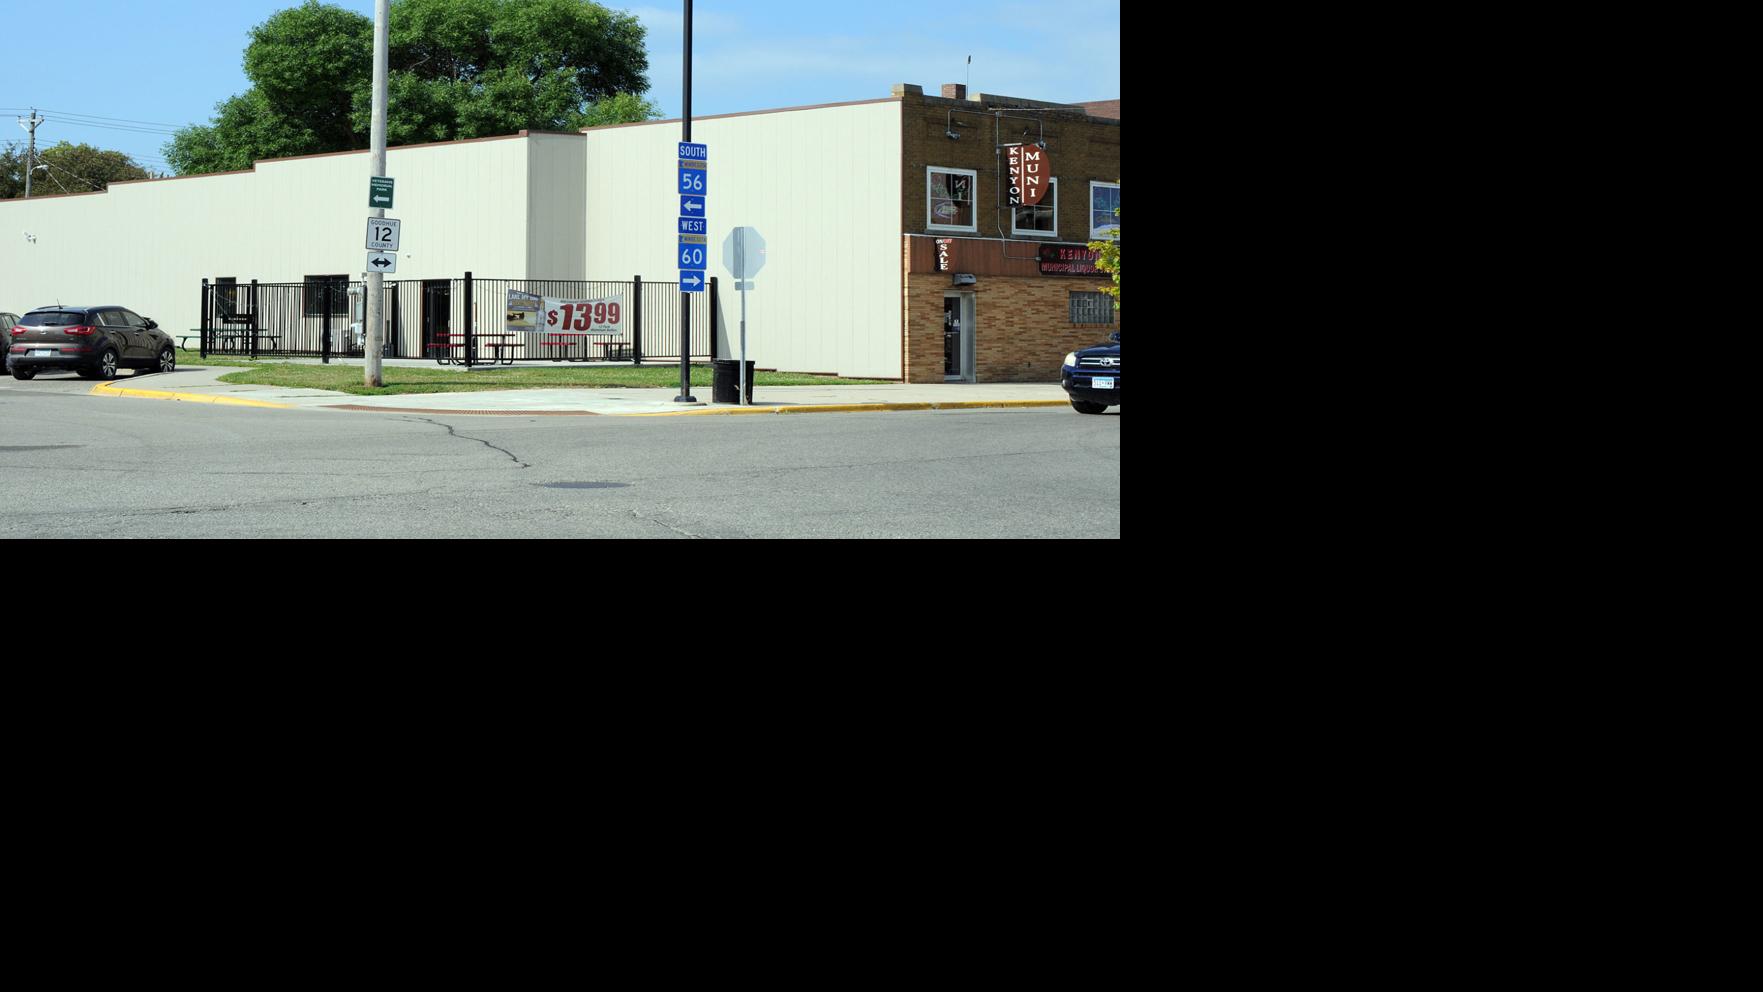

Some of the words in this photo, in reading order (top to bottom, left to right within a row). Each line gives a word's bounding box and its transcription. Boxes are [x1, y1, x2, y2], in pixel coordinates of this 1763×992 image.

[680, 145, 706, 158] SOUTH
[683, 173, 703, 190] 56
[1009, 147, 1020, 205] KENYON
[1025, 151, 1040, 198] MUNI
[682, 220, 704, 231] WEST
[375, 226, 392, 241] 12
[682, 249, 703, 264] 60
[939, 243, 949, 270] SALE
[1041, 262, 1075, 272] MUNICIPAL
